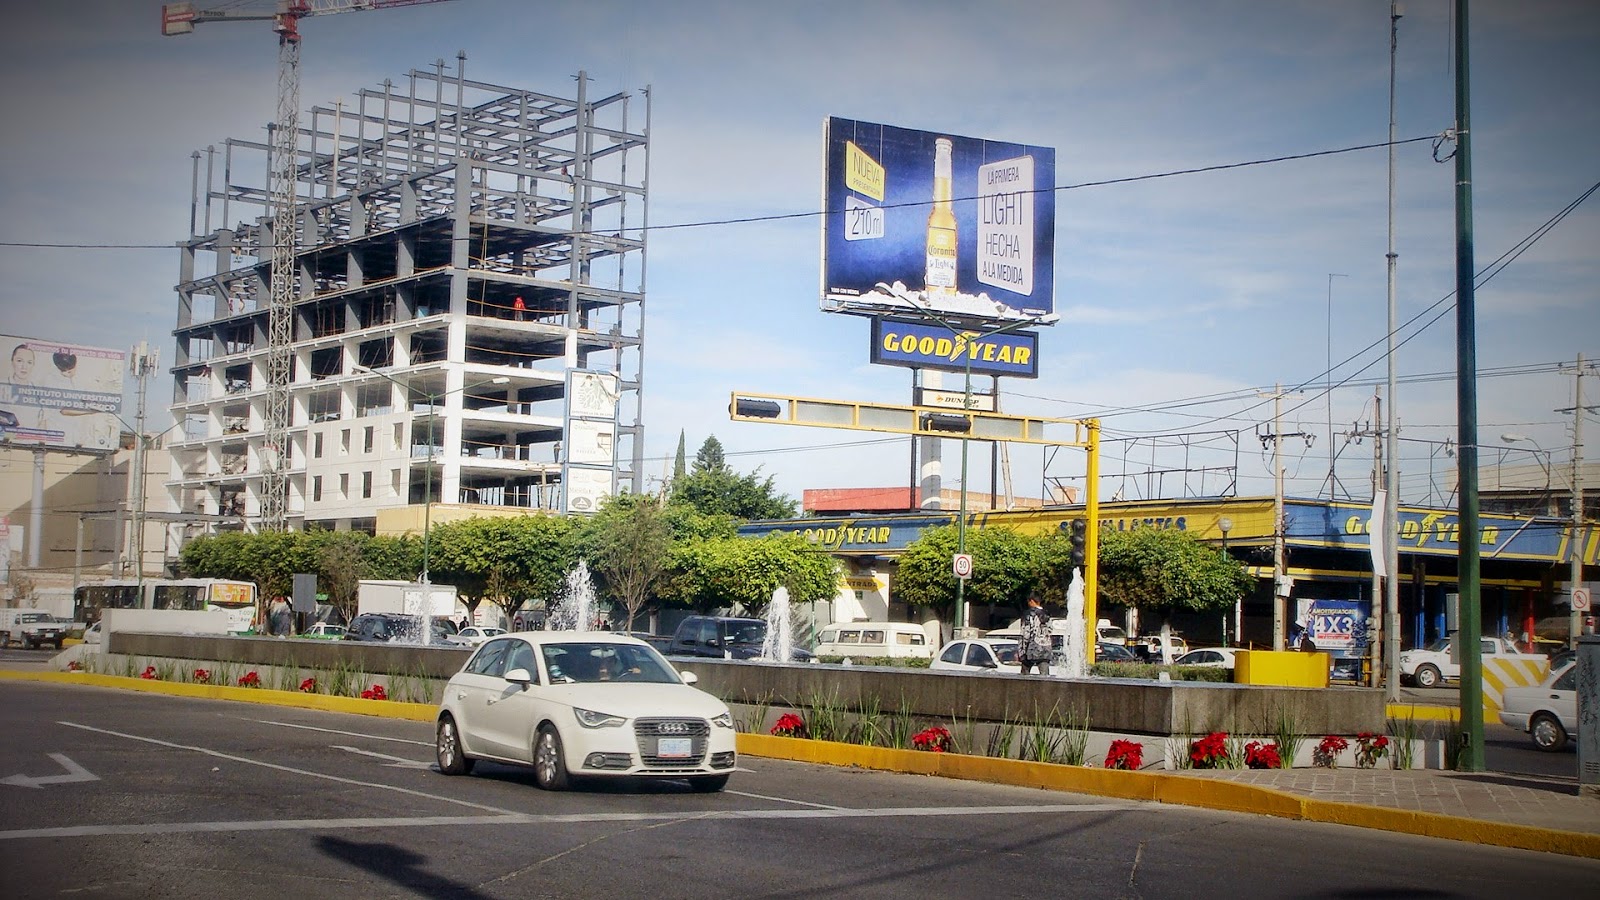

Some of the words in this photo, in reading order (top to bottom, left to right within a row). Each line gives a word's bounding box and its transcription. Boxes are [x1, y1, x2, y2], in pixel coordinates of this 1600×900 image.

[853, 152, 880, 185] NUEVA
[988, 170, 994, 185] LA
[995, 167, 1019, 182] PRIMERA
[983, 191, 1026, 225] LIGHT
[852, 207, 871, 234] 210
[986, 233, 1020, 259] HECHA
[983, 261, 987, 276] A
[988, 262, 996, 278] LA
[997, 263, 1023, 285] MEDIDA
[883, 333, 1031, 364] GOODYEAR
[18, 388, 61, 398] INSTITUTO
[62, 392, 120, 403] UNIVERSITARIO
[23, 396, 38, 404] DEL
[39, 398, 72, 407] CENTRO
[959, 560, 967, 569] 50
[1313, 615, 1353, 634] 4X3
